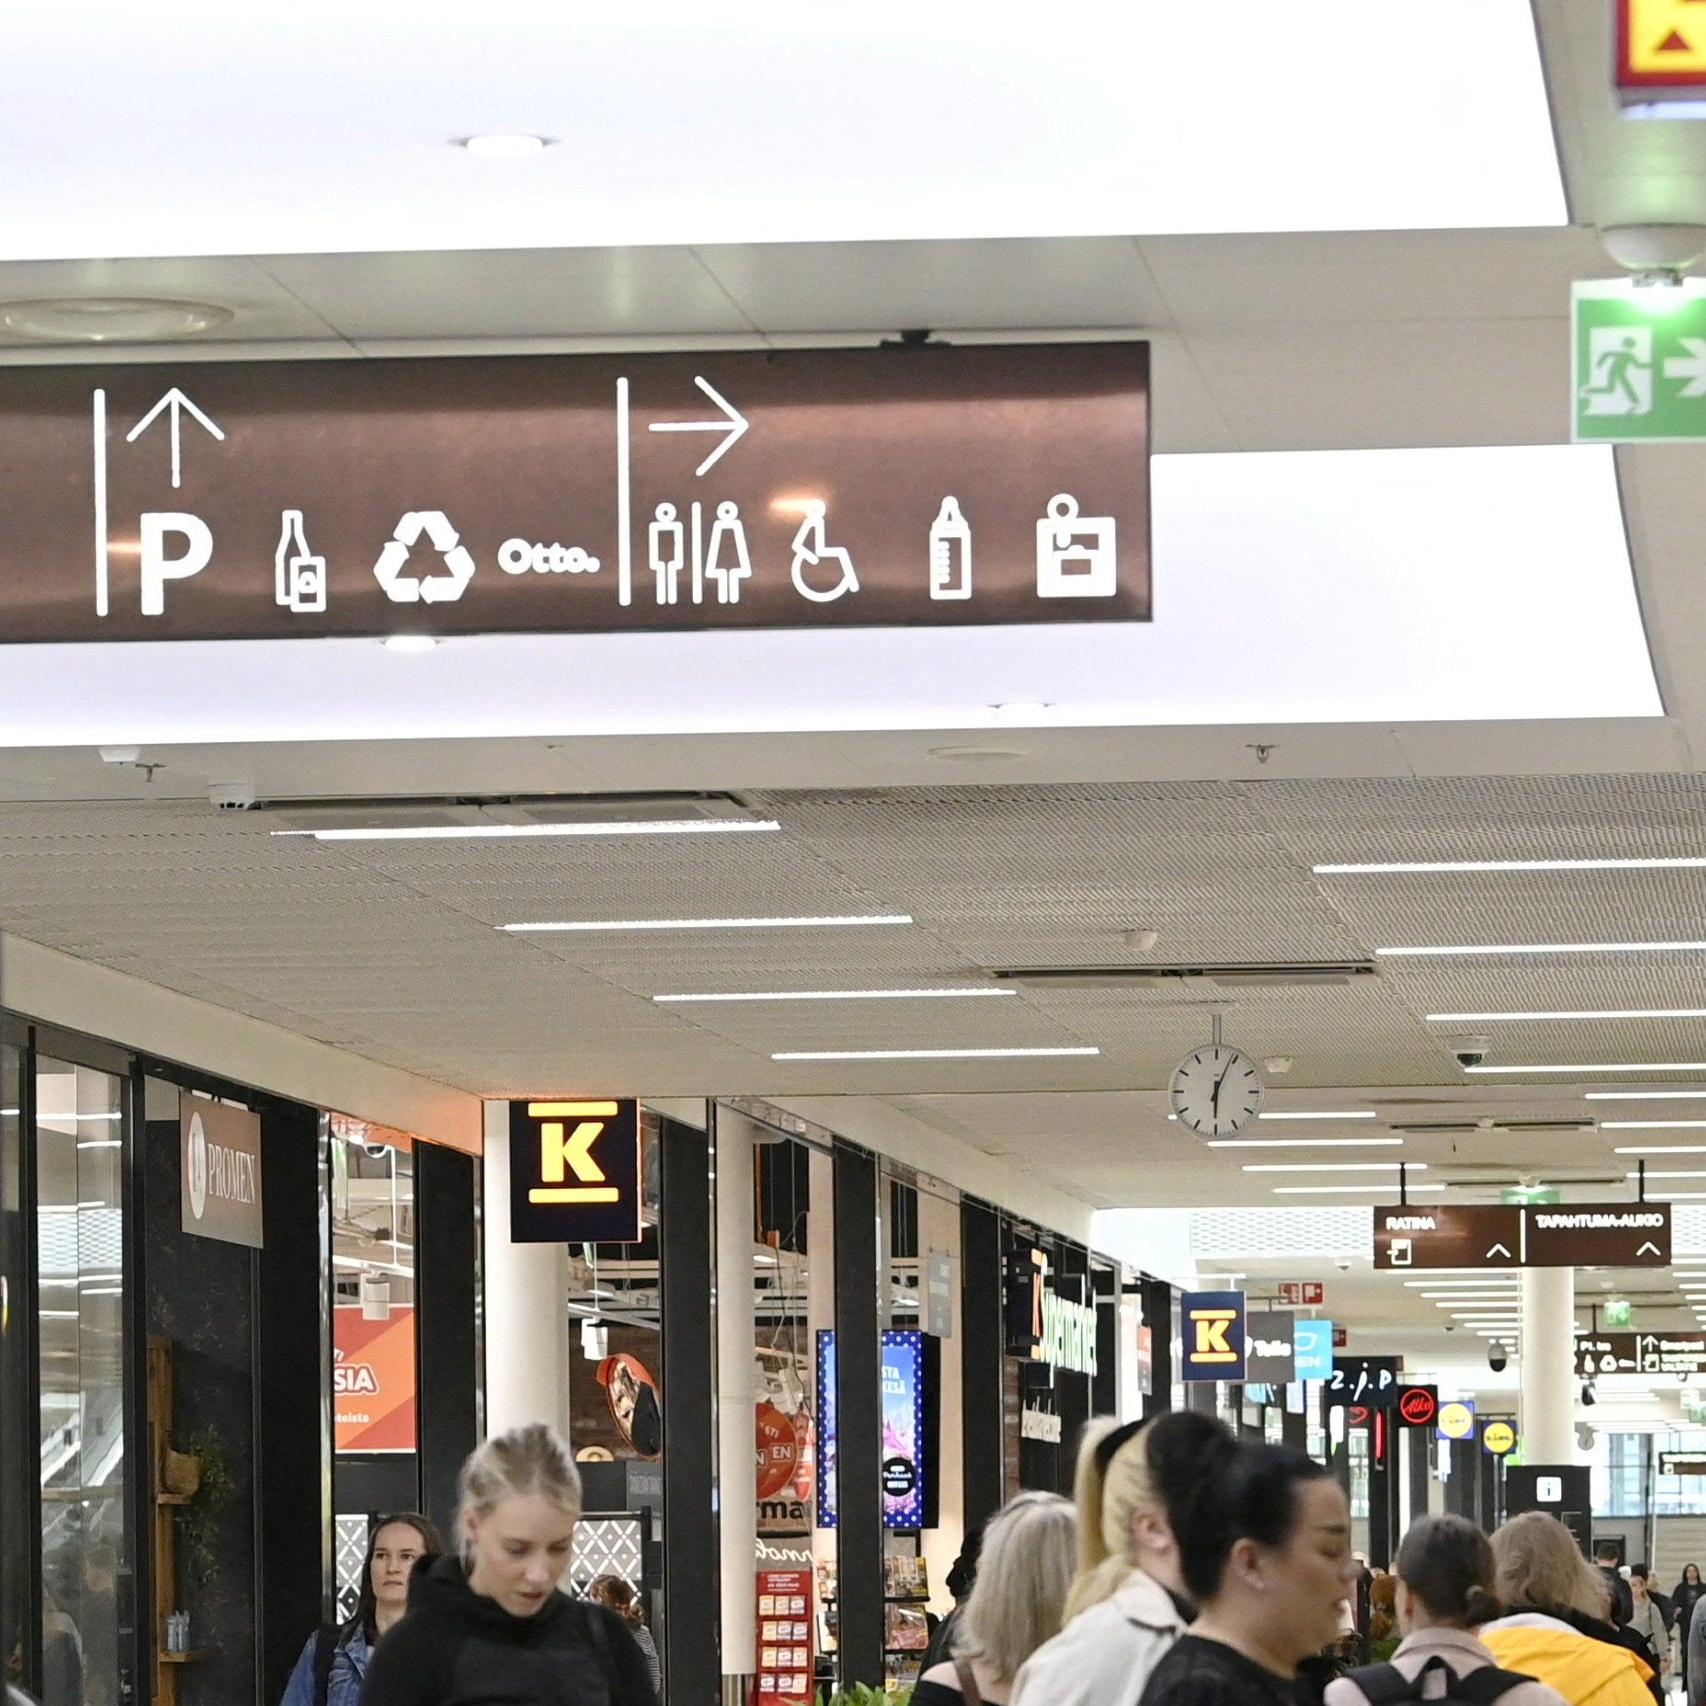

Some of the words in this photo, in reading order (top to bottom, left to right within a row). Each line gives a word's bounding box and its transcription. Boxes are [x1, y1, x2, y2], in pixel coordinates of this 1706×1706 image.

[140, 512, 214, 615] P
[540, 1121, 606, 1183] K
[207, 1142, 256, 1205] PROMEN
[1385, 1215, 1436, 1231] RATINA
[1196, 1319, 1231, 1352] K
[334, 1413, 370, 1423] teista
[756, 1501, 804, 1520] ma
